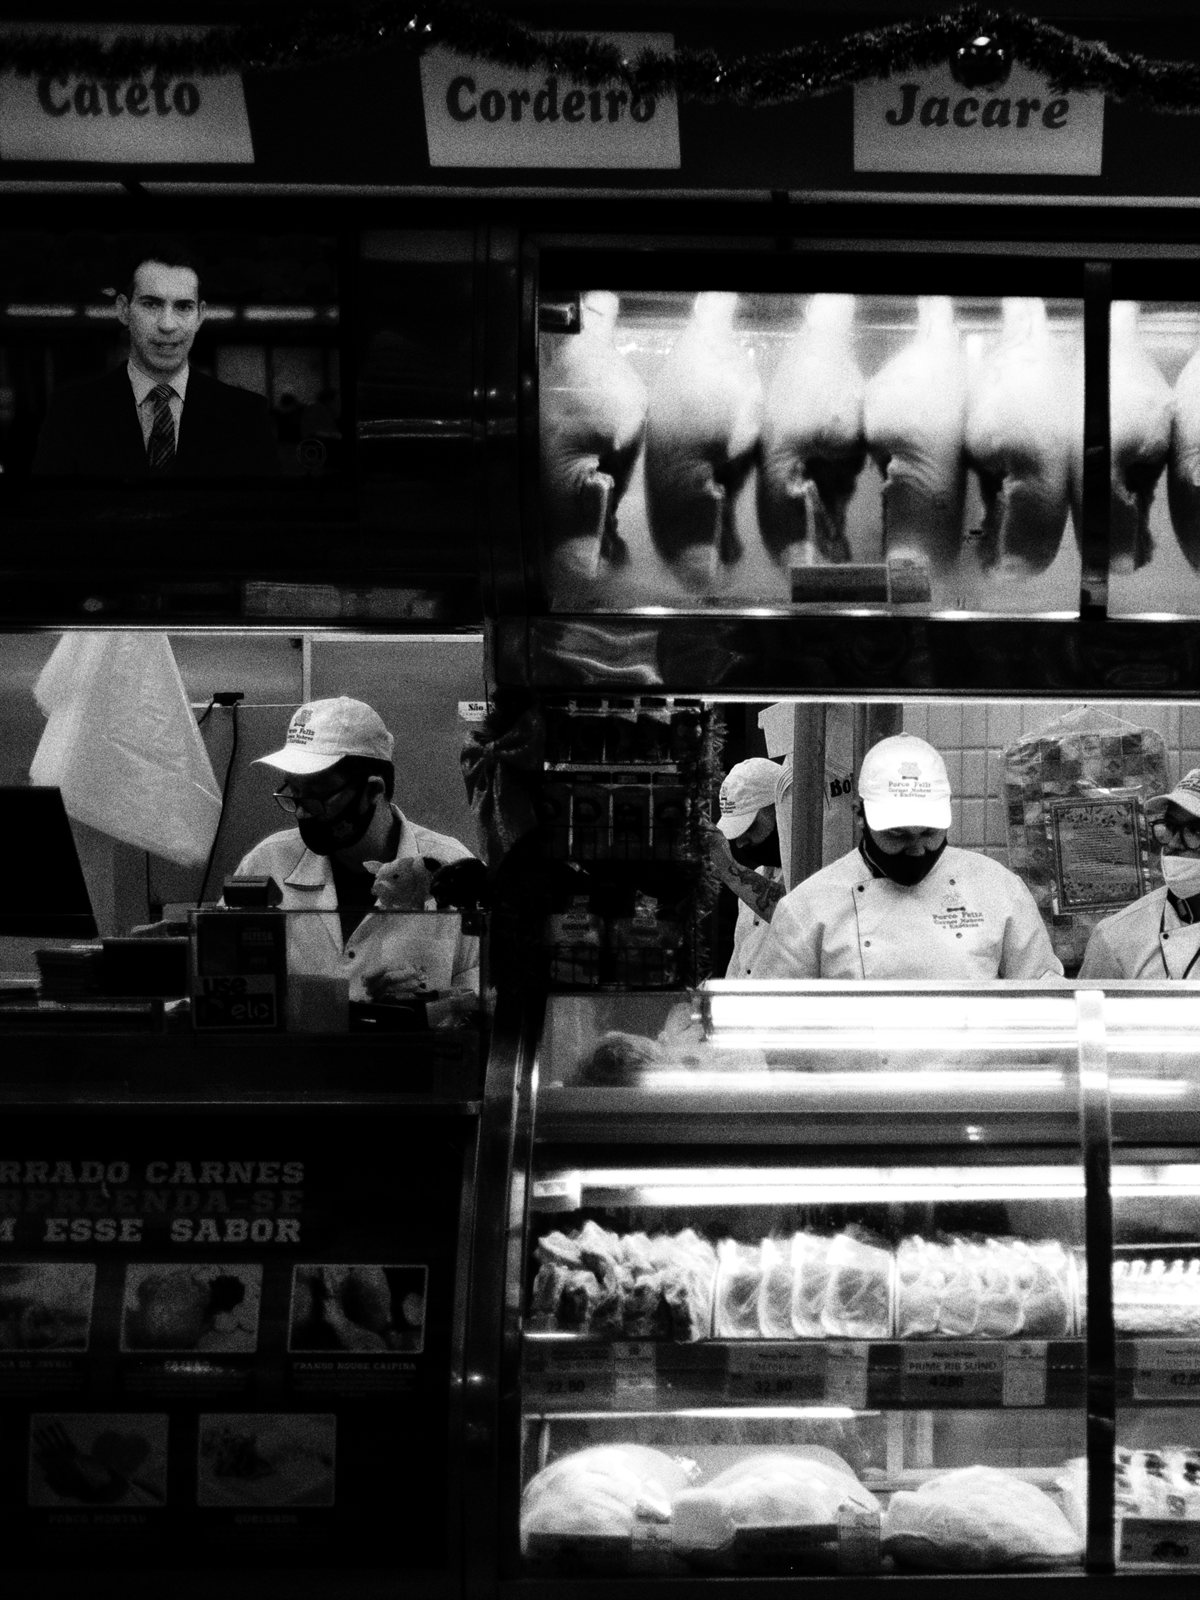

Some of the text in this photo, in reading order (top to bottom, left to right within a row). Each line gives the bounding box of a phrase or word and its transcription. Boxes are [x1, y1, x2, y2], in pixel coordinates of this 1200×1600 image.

[446, 76, 656, 123] Cordeiro
[145, 1160, 304, 1184] CARNES
[43, 1217, 145, 1242] ESSE
[170, 1217, 302, 1242] SABOR
